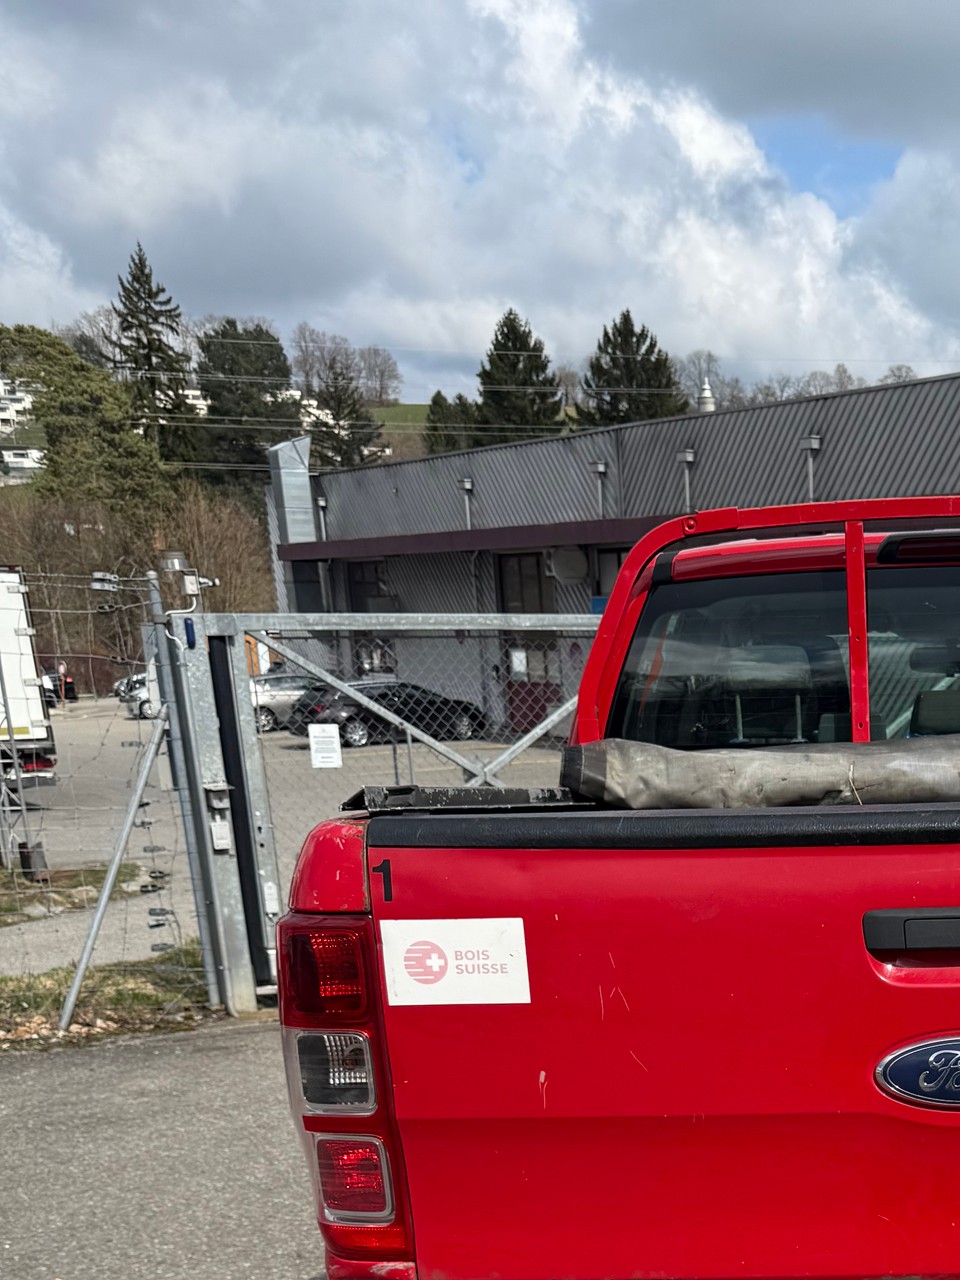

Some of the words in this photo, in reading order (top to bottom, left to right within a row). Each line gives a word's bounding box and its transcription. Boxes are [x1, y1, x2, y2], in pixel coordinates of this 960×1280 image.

[372, 859, 393, 902] 1
[454, 950, 490, 961] BOIS
[455, 963, 509, 975] SUISSE
